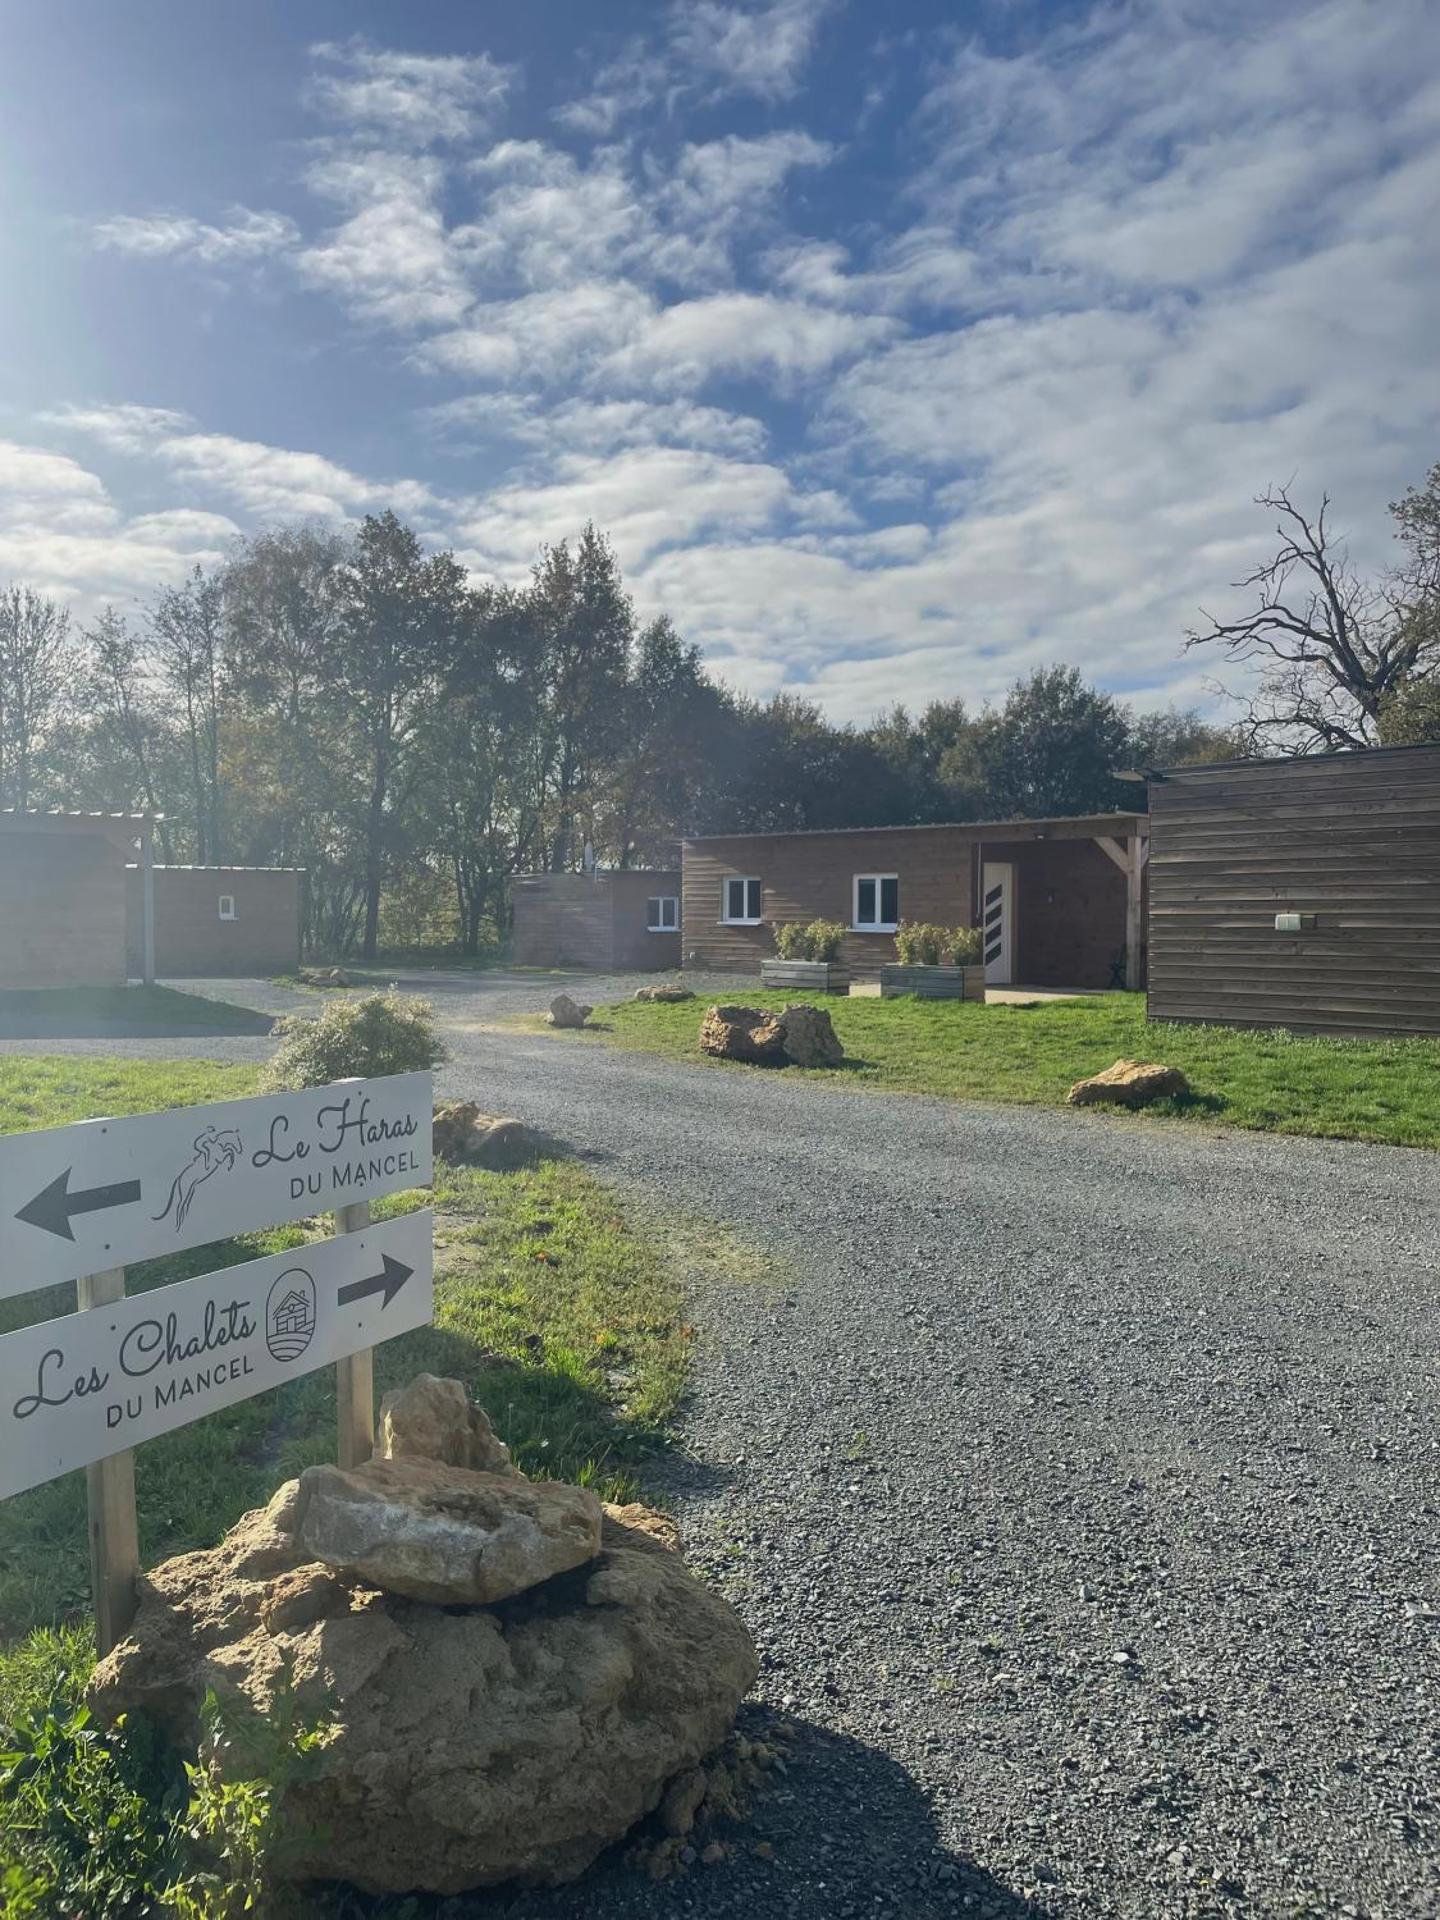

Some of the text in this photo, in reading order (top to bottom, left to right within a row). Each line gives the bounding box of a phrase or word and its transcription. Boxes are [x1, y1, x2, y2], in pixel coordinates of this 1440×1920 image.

[252, 1097, 418, 1168] Le Haras
[290, 1151, 419, 1199] DU MANCEL
[13, 1301, 256, 1419] Les Chalets
[106, 1355, 254, 1428] DU MANCEL
